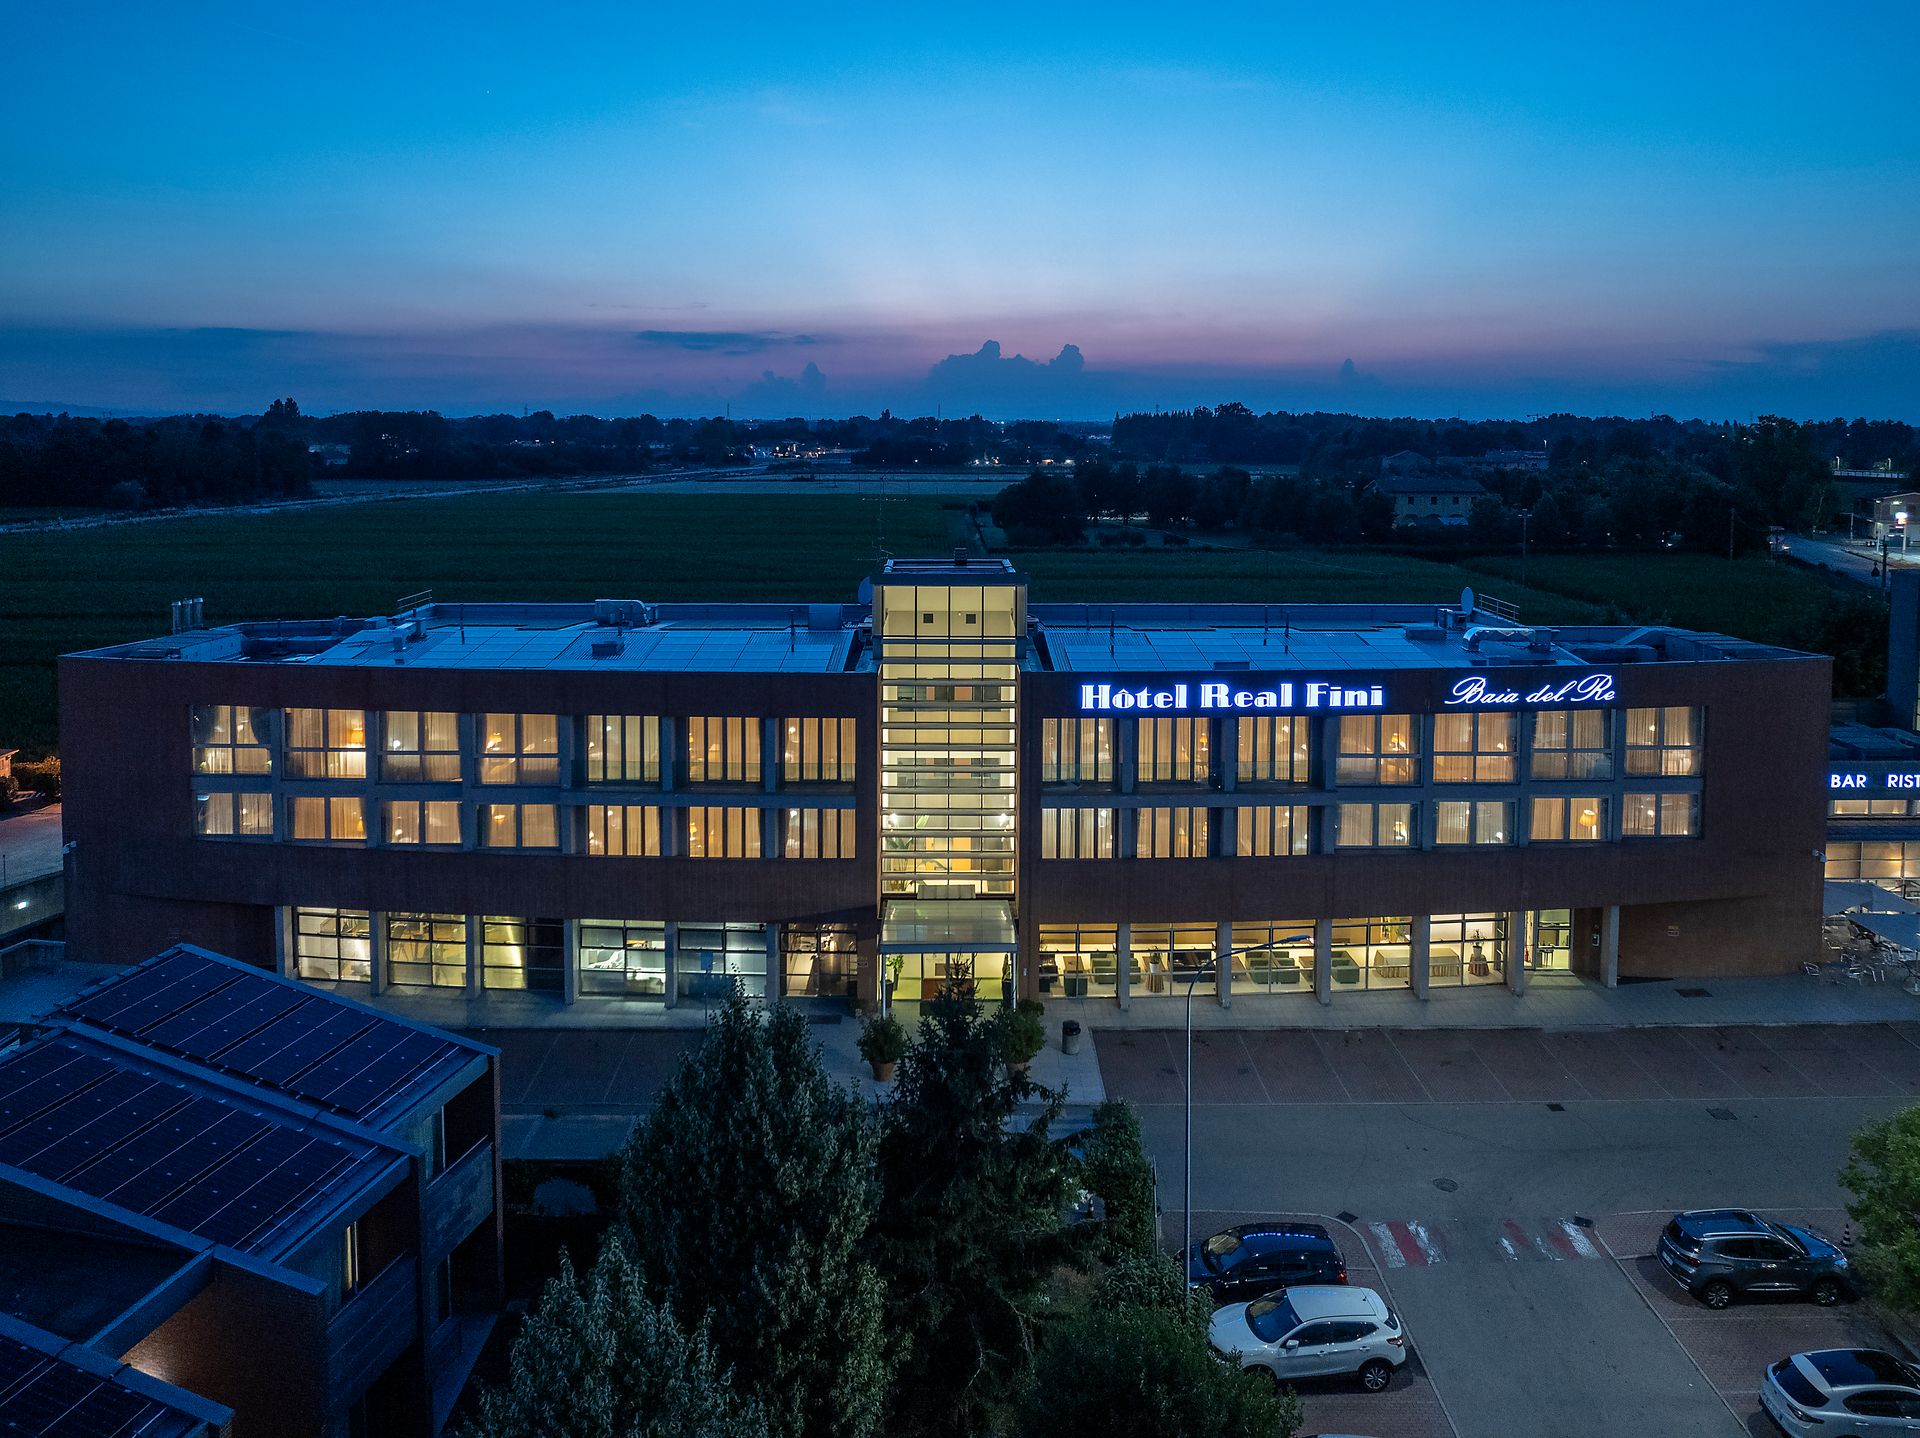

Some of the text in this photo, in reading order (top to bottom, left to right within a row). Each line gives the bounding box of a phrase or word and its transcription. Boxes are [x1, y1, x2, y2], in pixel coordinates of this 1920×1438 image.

[1081, 683, 1383, 710] Hôtel Real Fini
[1444, 673, 1616, 705] Baia del Re
[1830, 774, 1867, 788] BAR
